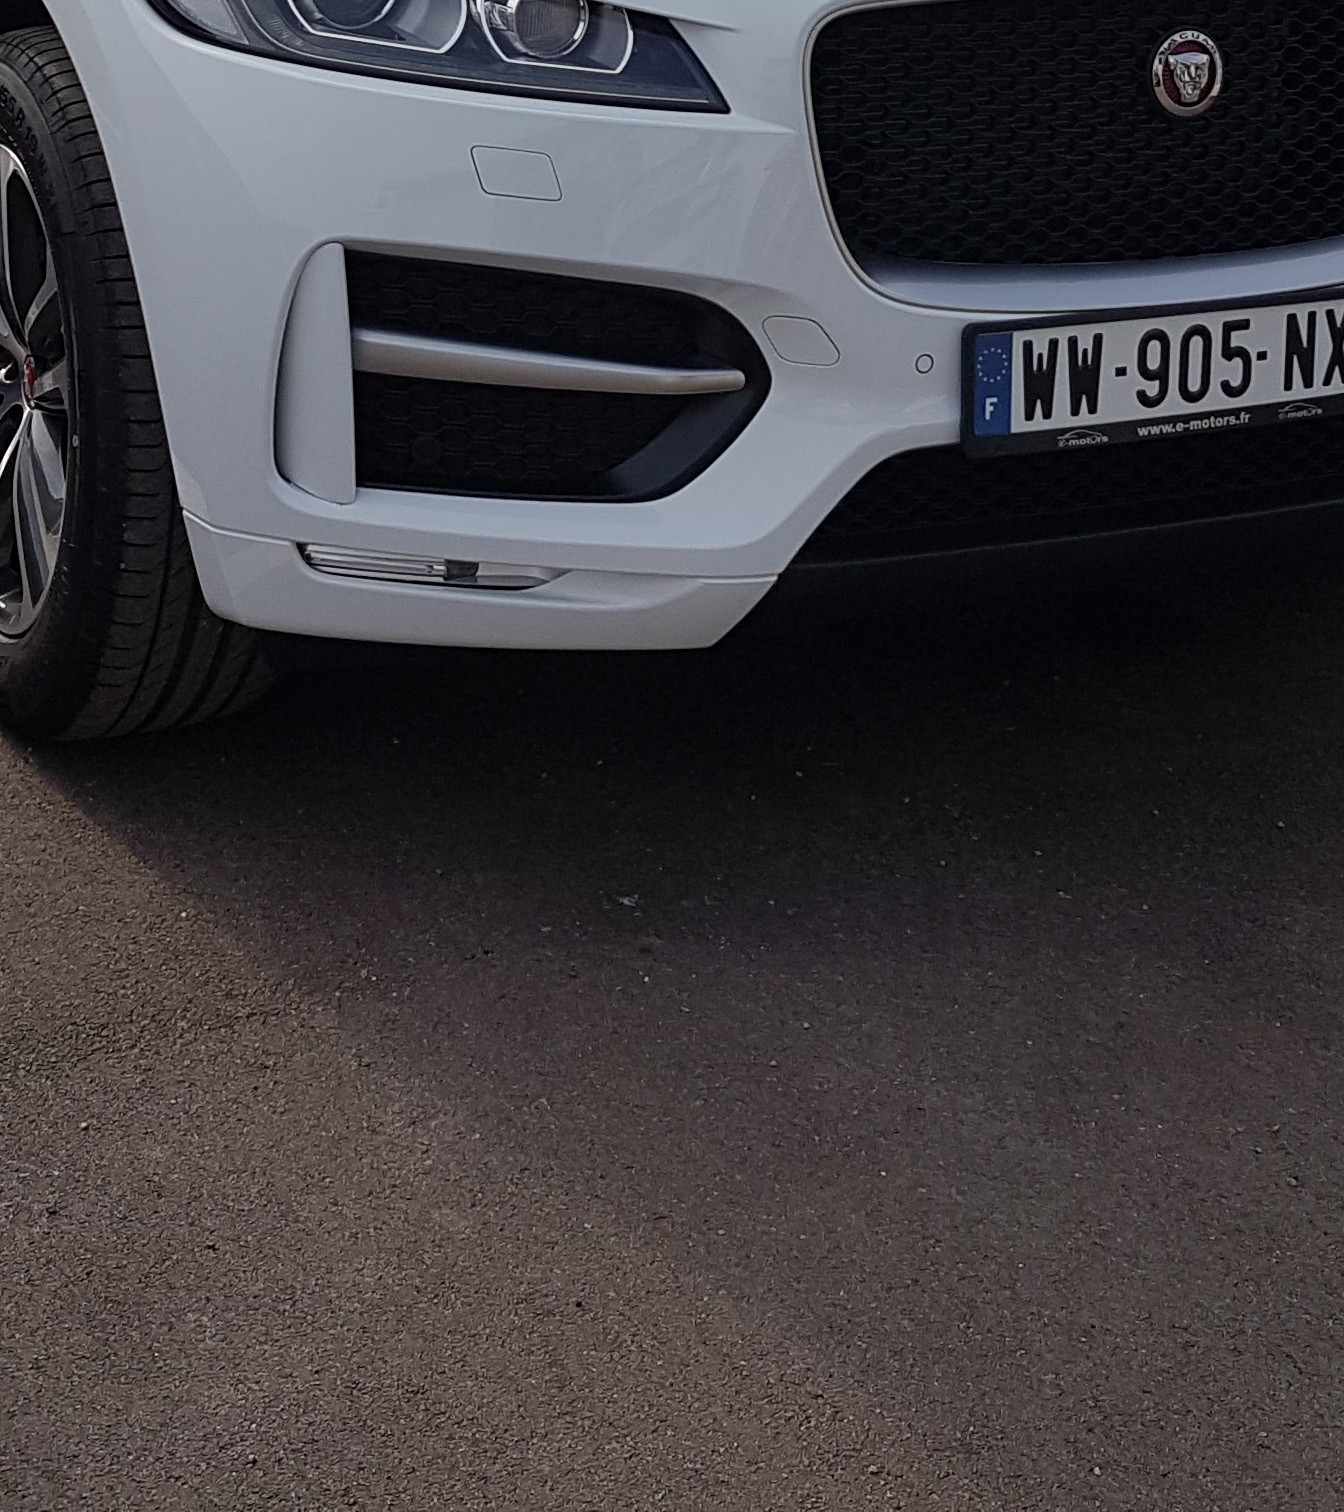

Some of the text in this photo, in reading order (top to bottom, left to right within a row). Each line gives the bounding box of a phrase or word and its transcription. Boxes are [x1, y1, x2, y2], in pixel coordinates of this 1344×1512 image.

[1158, 32, 1218, 66] JAGUAR
[985, 397, 998, 420] F
[1137, 412, 1251, 437] www.e-motors.fr
